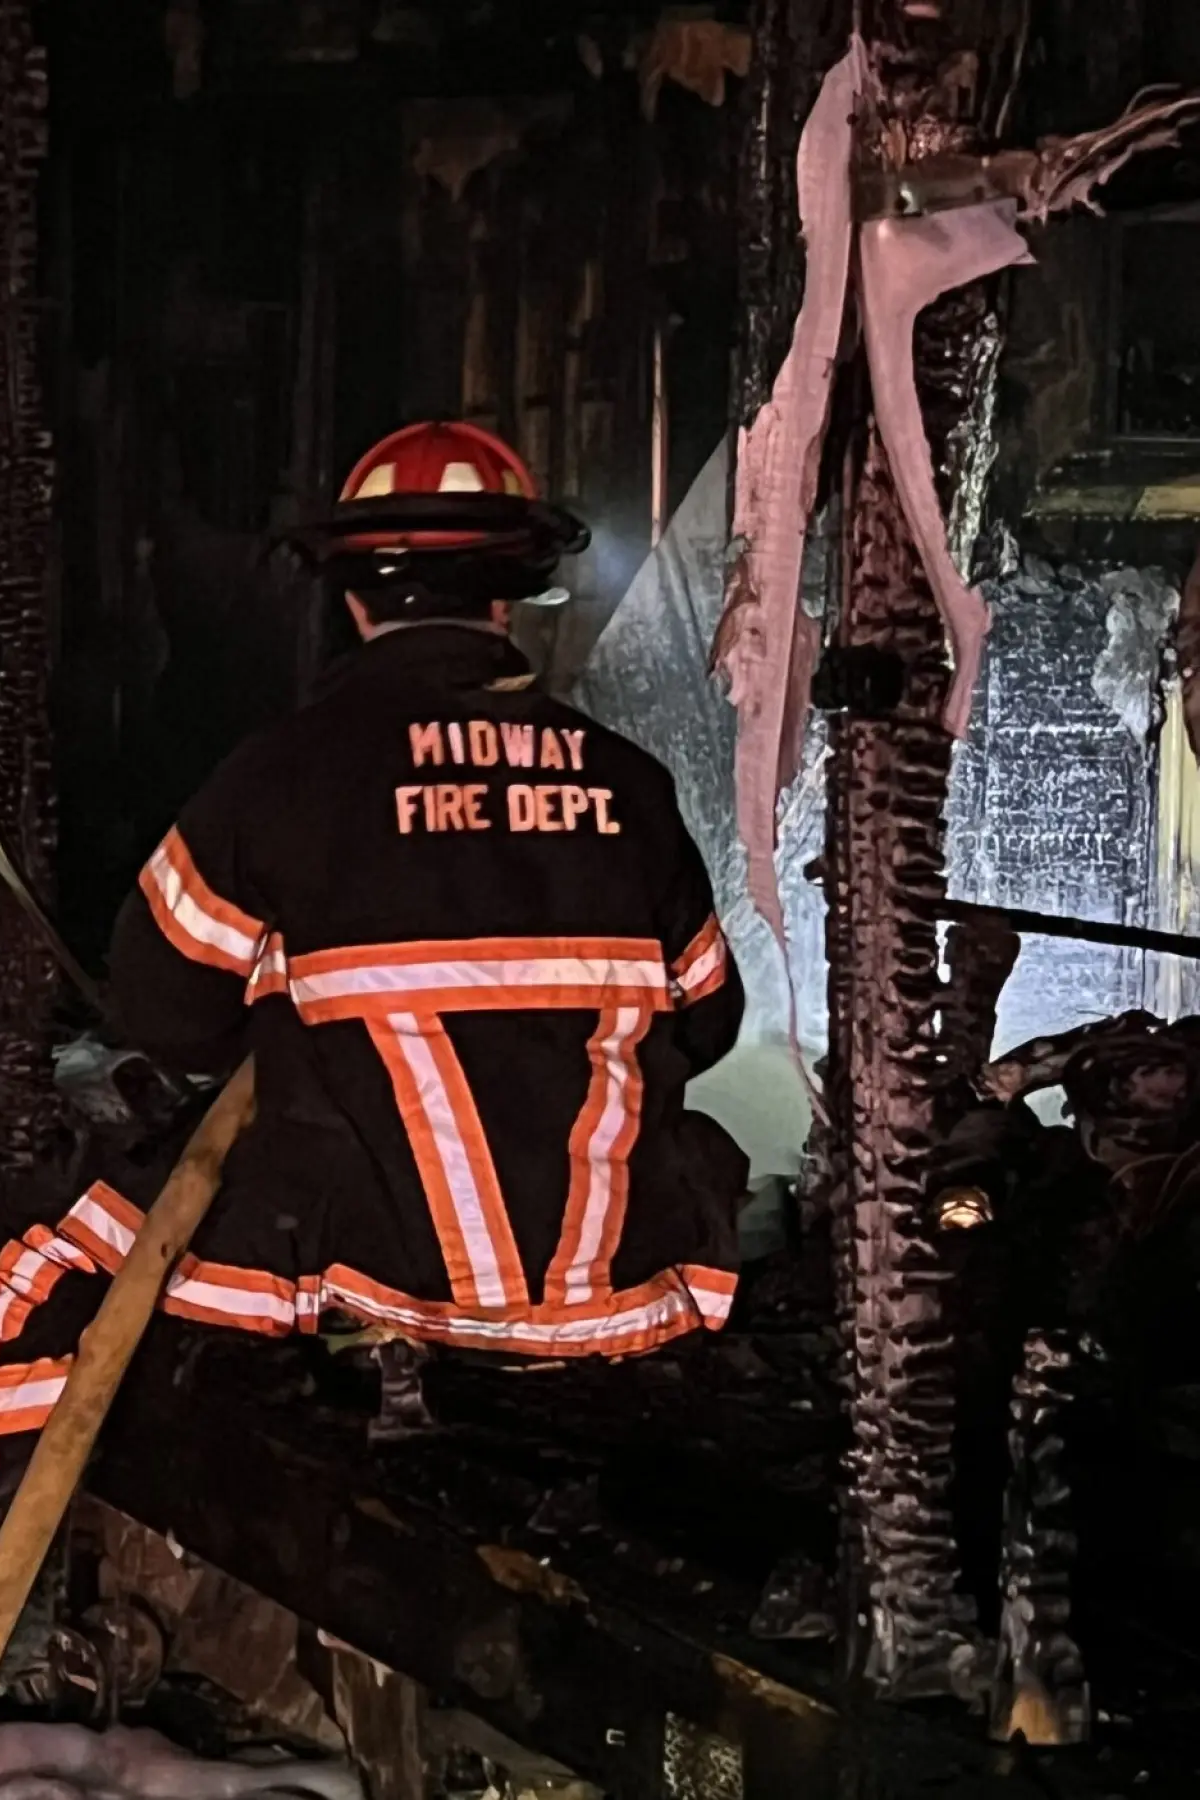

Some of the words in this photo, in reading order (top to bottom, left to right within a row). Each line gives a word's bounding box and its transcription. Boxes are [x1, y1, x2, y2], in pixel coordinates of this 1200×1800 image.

[408, 720, 586, 771] MIDWAY
[395, 784, 492, 834] FIRE
[507, 784, 620, 834] DEPT.
